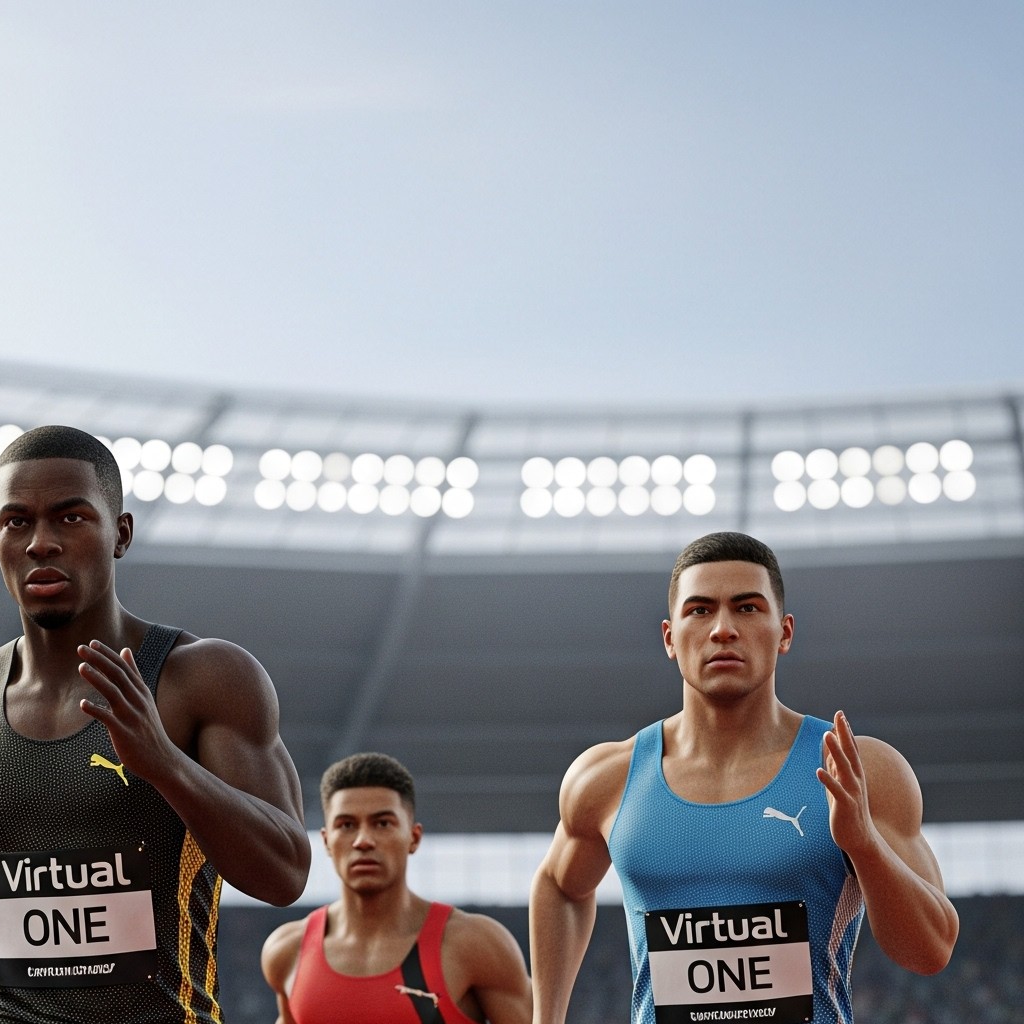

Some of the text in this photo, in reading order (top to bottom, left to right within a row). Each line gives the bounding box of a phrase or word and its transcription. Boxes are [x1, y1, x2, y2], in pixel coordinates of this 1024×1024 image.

[2, 853, 131, 892] Virtual
[23, 906, 109, 946] ONE
[659, 909, 788, 945] Virtual
[687, 956, 773, 994] ONE
